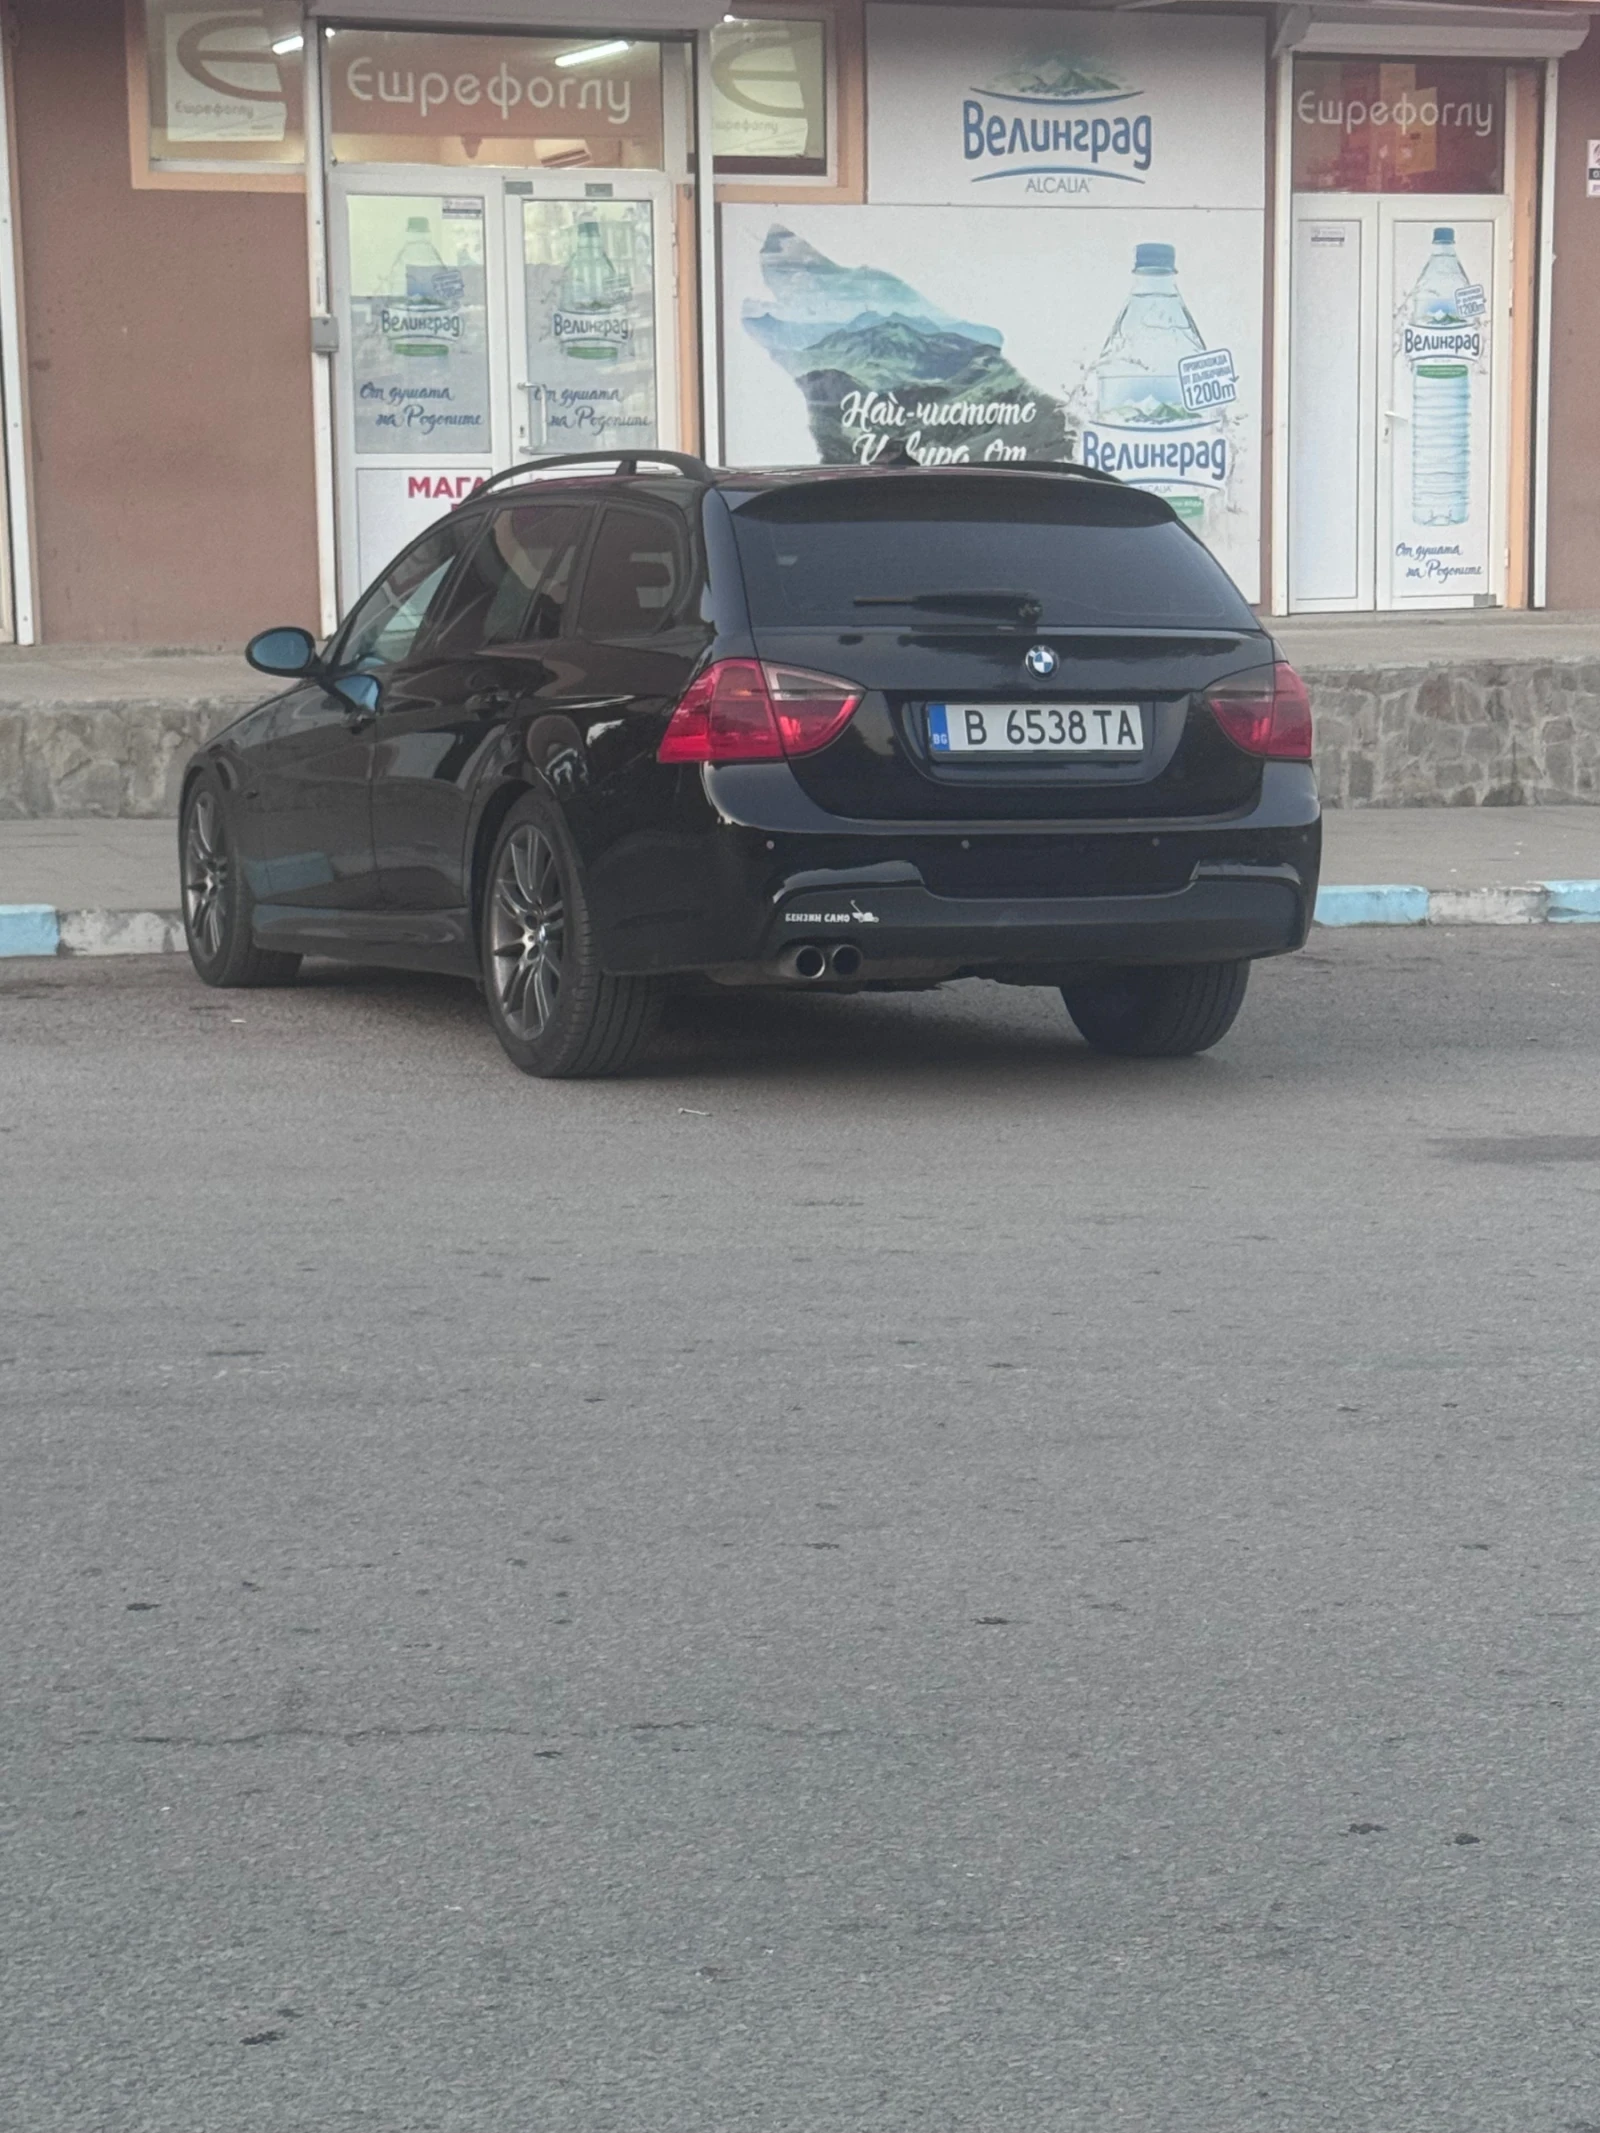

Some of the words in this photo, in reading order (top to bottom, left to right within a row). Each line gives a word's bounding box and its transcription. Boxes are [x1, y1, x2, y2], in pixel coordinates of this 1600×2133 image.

[346, 56, 630, 124] Ешрефоглу
[1297, 90, 1493, 137] Ешрефоглу
[963, 99, 1152, 171] Велинград
[1025, 177, 1091, 193] ALCALIA
[381, 310, 460, 338] Велинград
[553, 313, 629, 340] Велинград
[1404, 328, 1480, 357] Велинград
[360, 381, 387, 401] От
[387, 386, 456, 407] душата
[560, 387, 625, 408] душата
[1186, 380, 1237, 407] 1200m
[375, 413, 402, 428] на
[402, 403, 485, 436] Родопите
[547, 414, 575, 429] на
[574, 405, 654, 436] Родопите
[840, 390, 1038, 433] Най-чистото
[1082, 430, 1227, 481] Велинград
[1396, 542, 1414, 558] От
[1415, 544, 1464, 562] душата
[1405, 566, 1427, 578] на
[1426, 559, 1484, 584] Родопите
[932, 733, 948, 745] BG
[964, 709, 988, 746] B
[1006, 710, 1087, 746] 6538
[1092, 709, 1137, 746] TA
[823, 913, 851, 923] САМО
